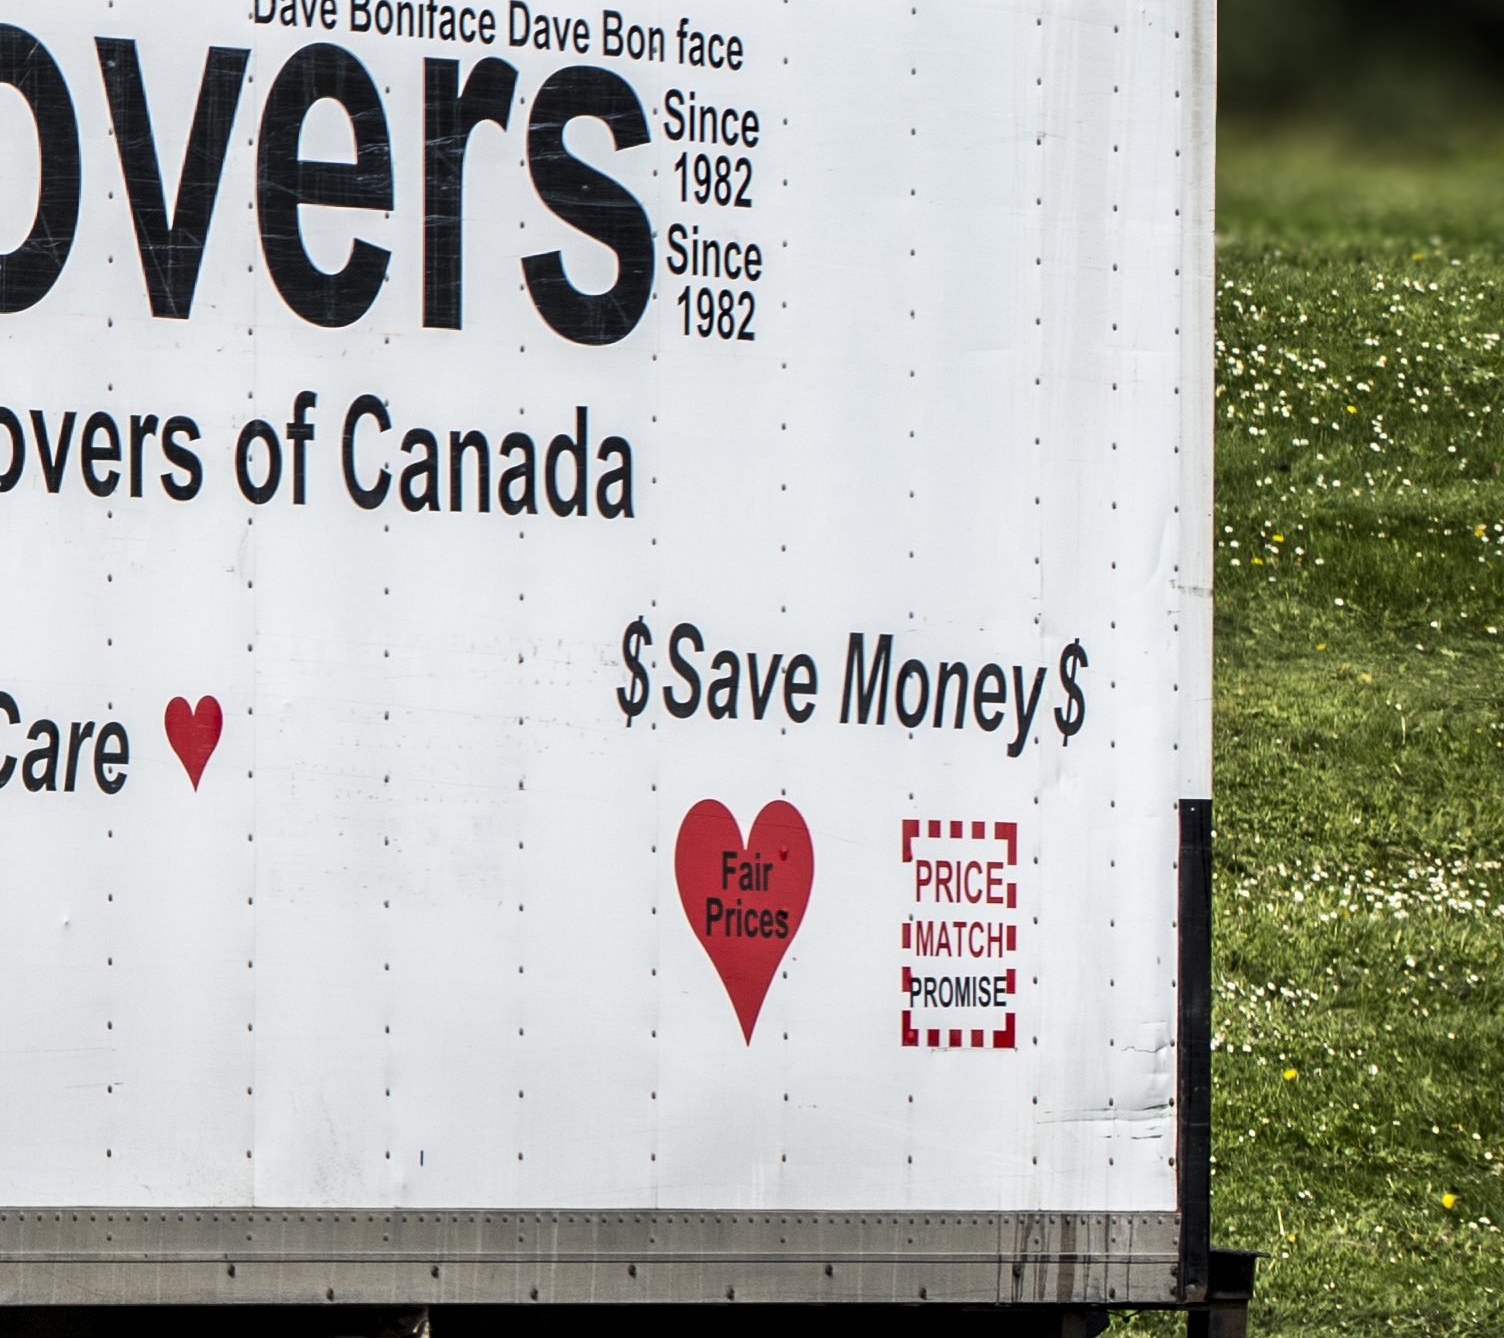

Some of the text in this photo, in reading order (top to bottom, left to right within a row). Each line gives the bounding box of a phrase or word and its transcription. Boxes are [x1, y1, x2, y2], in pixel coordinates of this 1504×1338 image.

[509, 0, 590, 53] Dave
[664, 89, 760, 147] Since
[674, 151, 753, 208] 1982
[666, 224, 762, 282] Since
[677, 286, 756, 341] 1982
[235, 391, 318, 505] of
[341, 394, 636, 519] Canada
[722, 850, 773, 893] Fair
[915, 860, 1005, 905] PRICE
[705, 897, 788, 940] Prices
[915, 920, 1004, 959] MATCH
[909, 975, 1008, 1009] PROMISE
